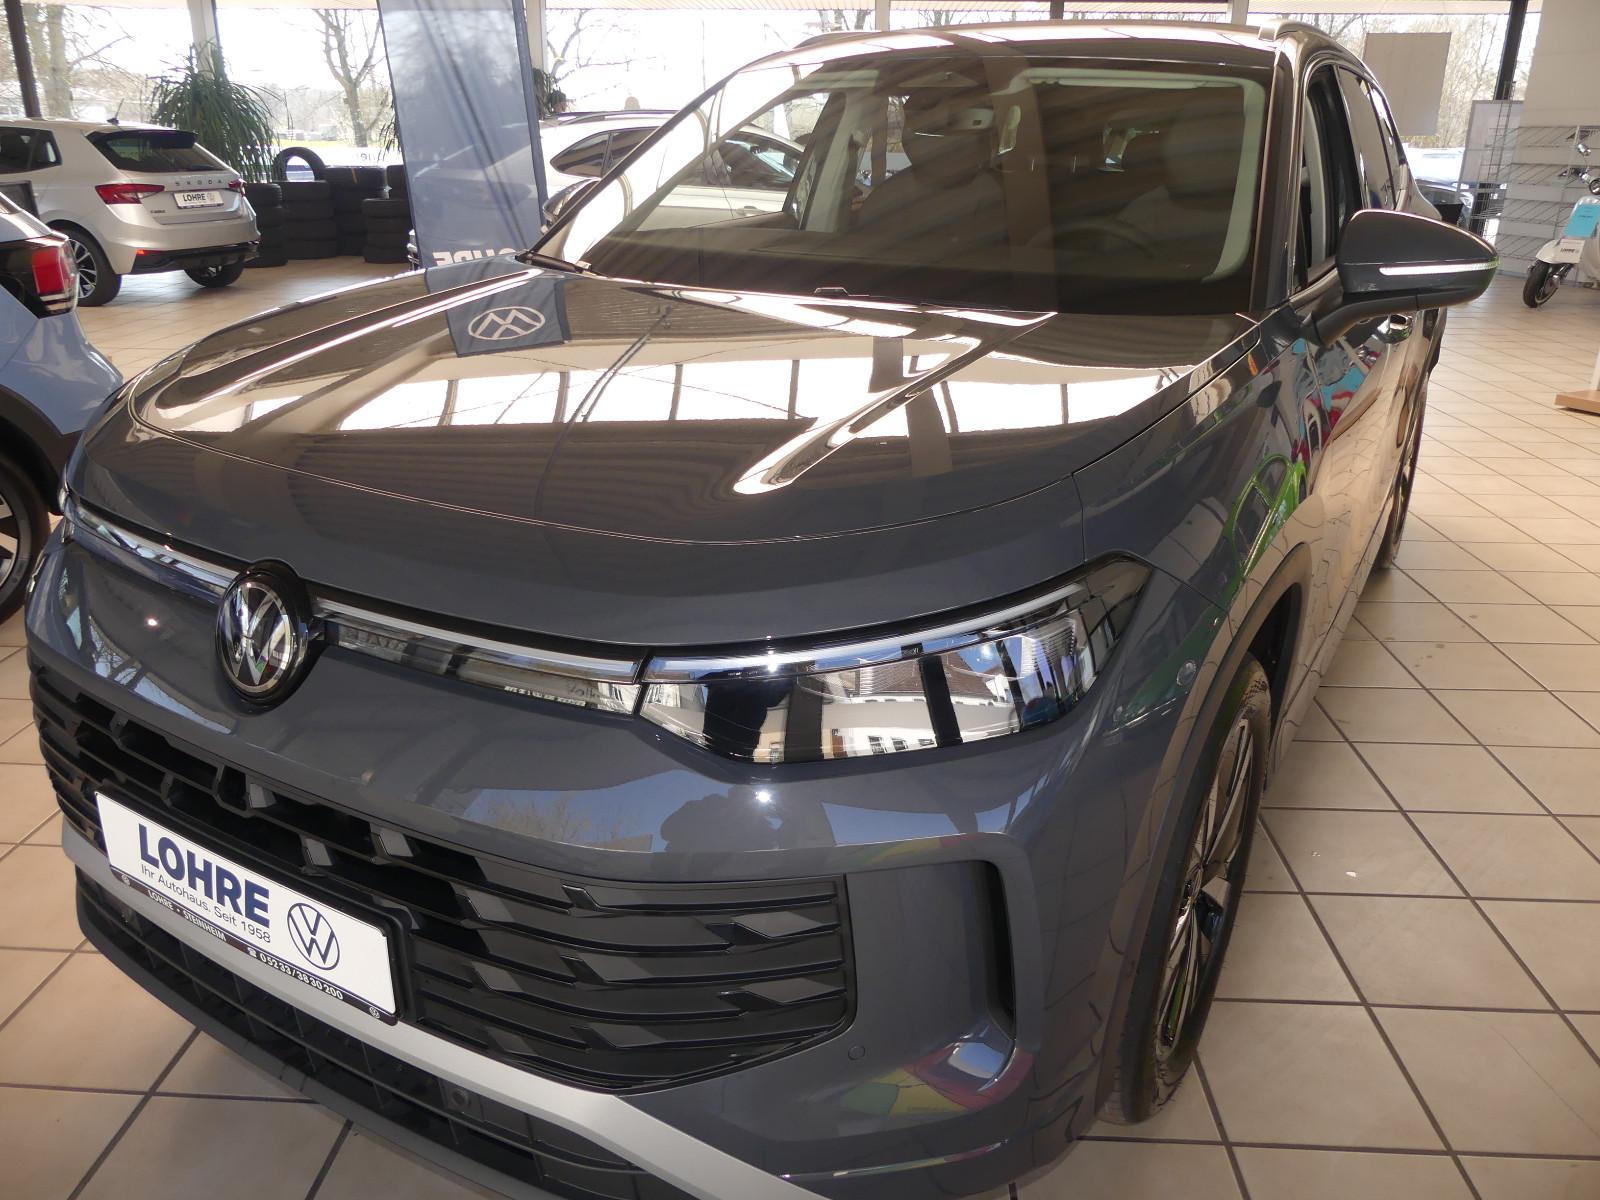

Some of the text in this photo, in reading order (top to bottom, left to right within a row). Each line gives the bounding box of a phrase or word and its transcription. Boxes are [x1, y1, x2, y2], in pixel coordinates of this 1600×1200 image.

[182, 193, 206, 202] LOHRE
[138, 823, 270, 928] LOHRE
[141, 863, 271, 943] Ihr Autohaus. Seit 1958
[147, 889, 227, 942] LOHRE STEINHEIM
